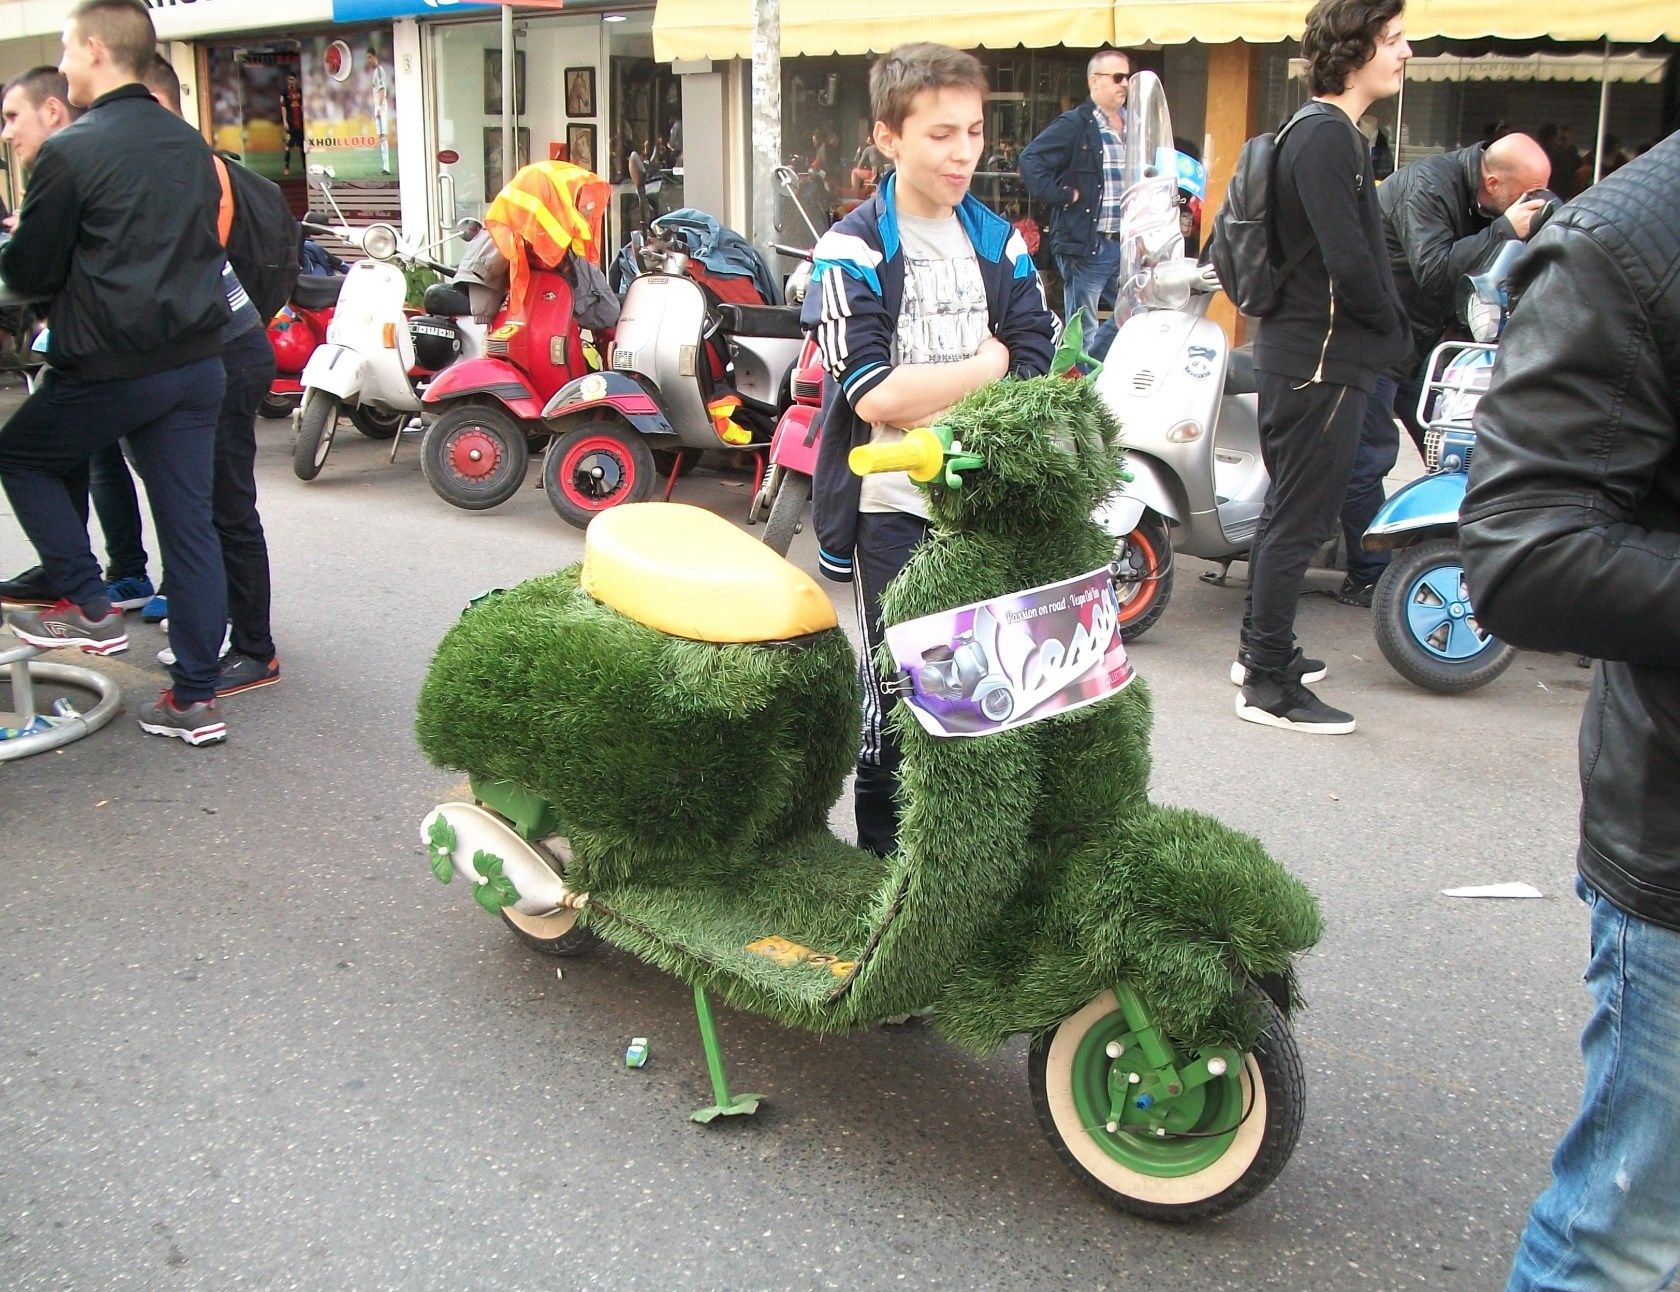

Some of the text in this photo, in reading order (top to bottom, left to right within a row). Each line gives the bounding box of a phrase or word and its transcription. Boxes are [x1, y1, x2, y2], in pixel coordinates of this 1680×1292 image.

[1005, 608, 1038, 624] Passion
[1038, 604, 1049, 616] on
[1049, 597, 1067, 613] road
